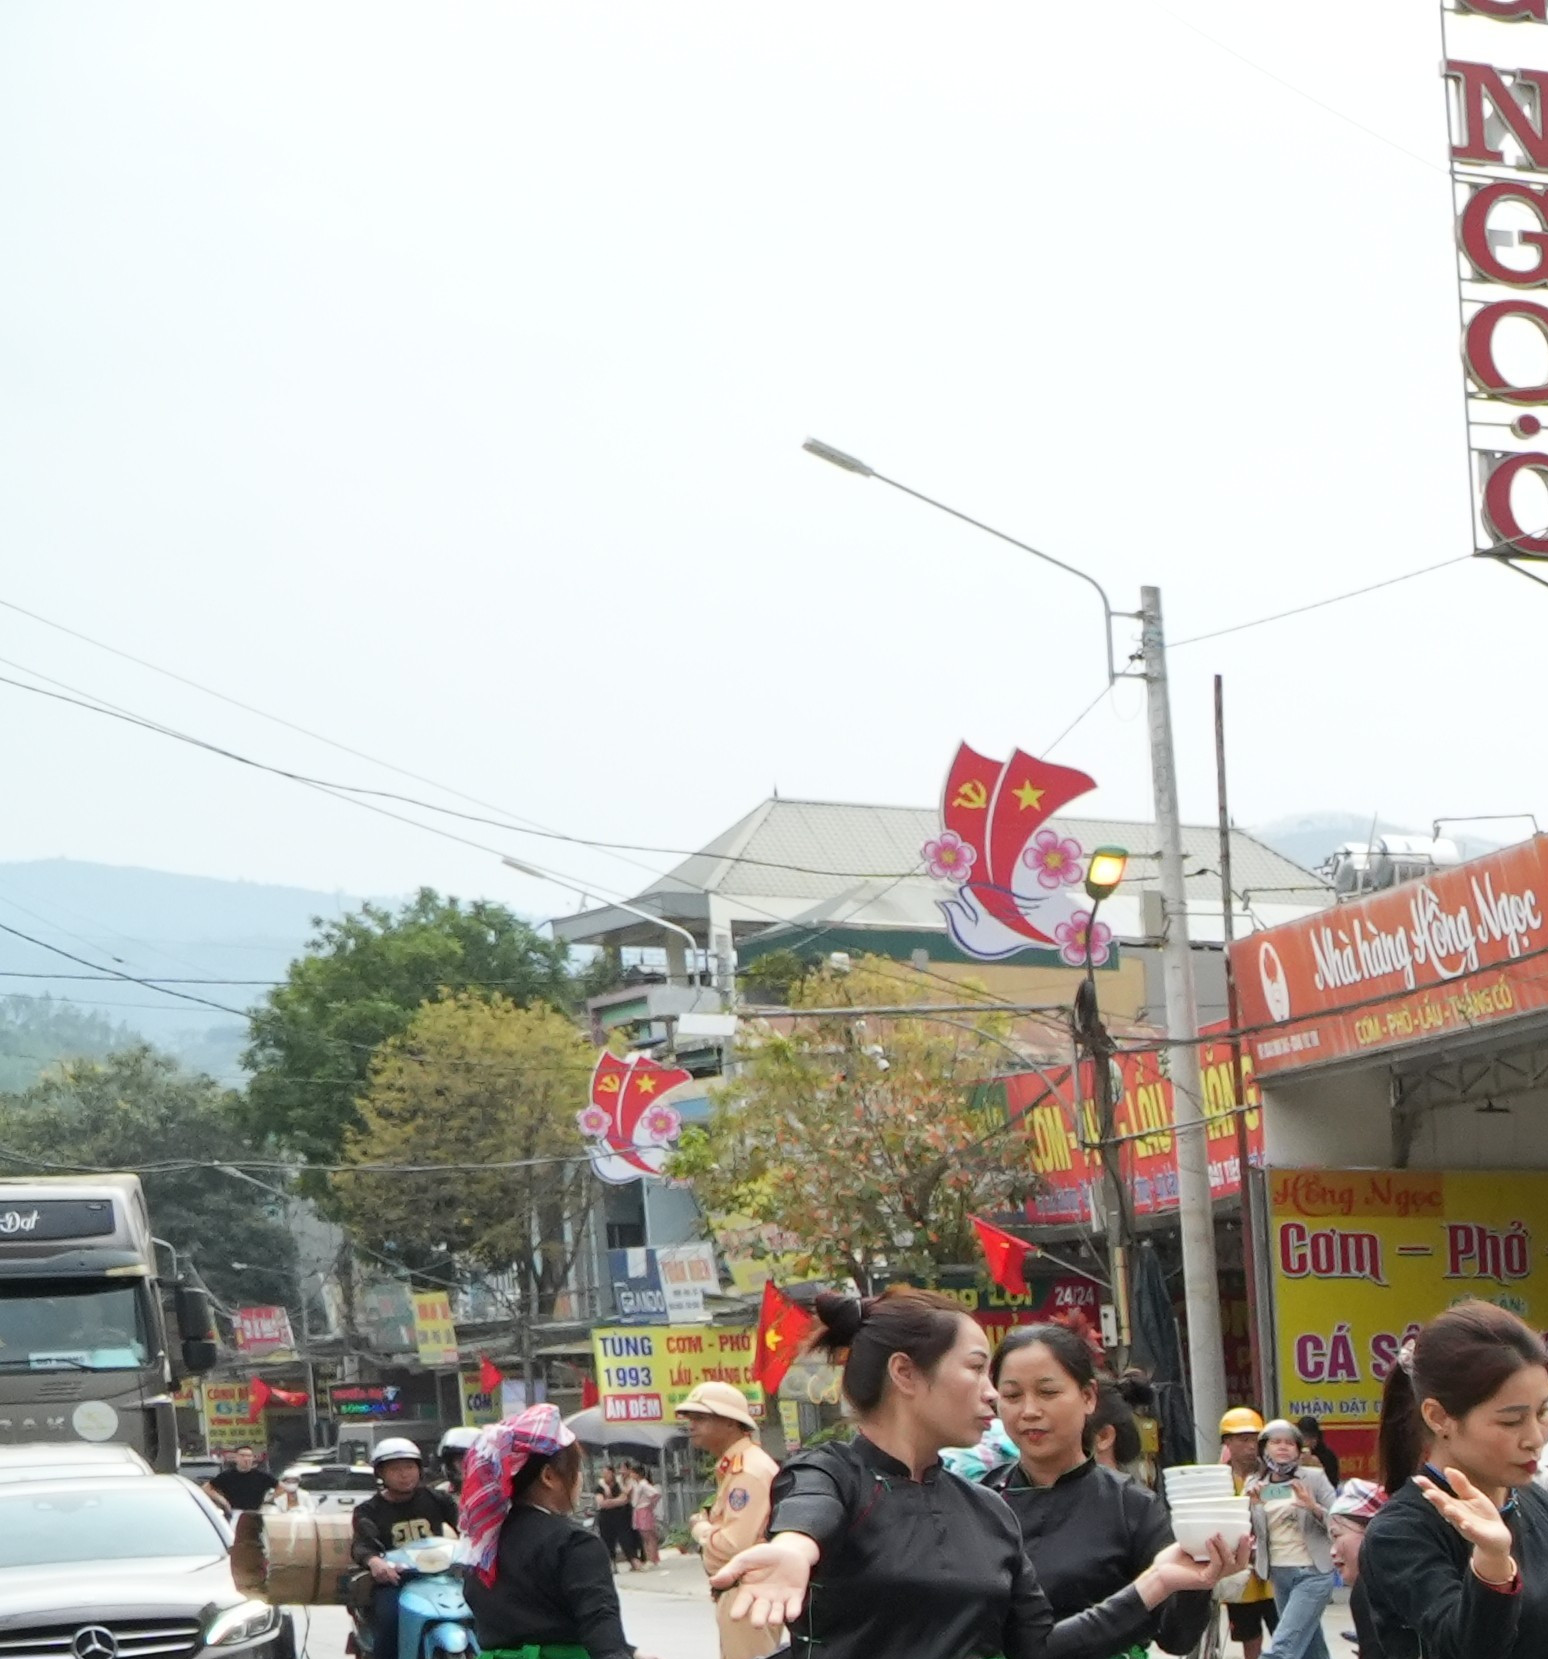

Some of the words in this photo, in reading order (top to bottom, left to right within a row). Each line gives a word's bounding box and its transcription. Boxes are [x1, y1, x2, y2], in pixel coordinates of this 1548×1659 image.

[1309, 924, 1361, 991] Nhà
[1353, 918, 1417, 989] hàng
[1410, 883, 1480, 981] Hồng
[1470, 871, 1542, 959] Ngọc
[1272, 1172, 1358, 1217] Hồng
[1364, 1177, 1444, 1219] Ngọc
[1279, 1222, 1389, 1287] Cơm
[1443, 1219, 1531, 1287] Phở
[599, 1331, 653, 1358] TÙNG
[666, 1332, 703, 1355] CƠM
[1296, 1323, 1361, 1384] CÁ
[604, 1367, 653, 1389] 1993
[628, 1393, 662, 1419] ĐÊM
[1289, 1397, 1334, 1418] NHẬN
